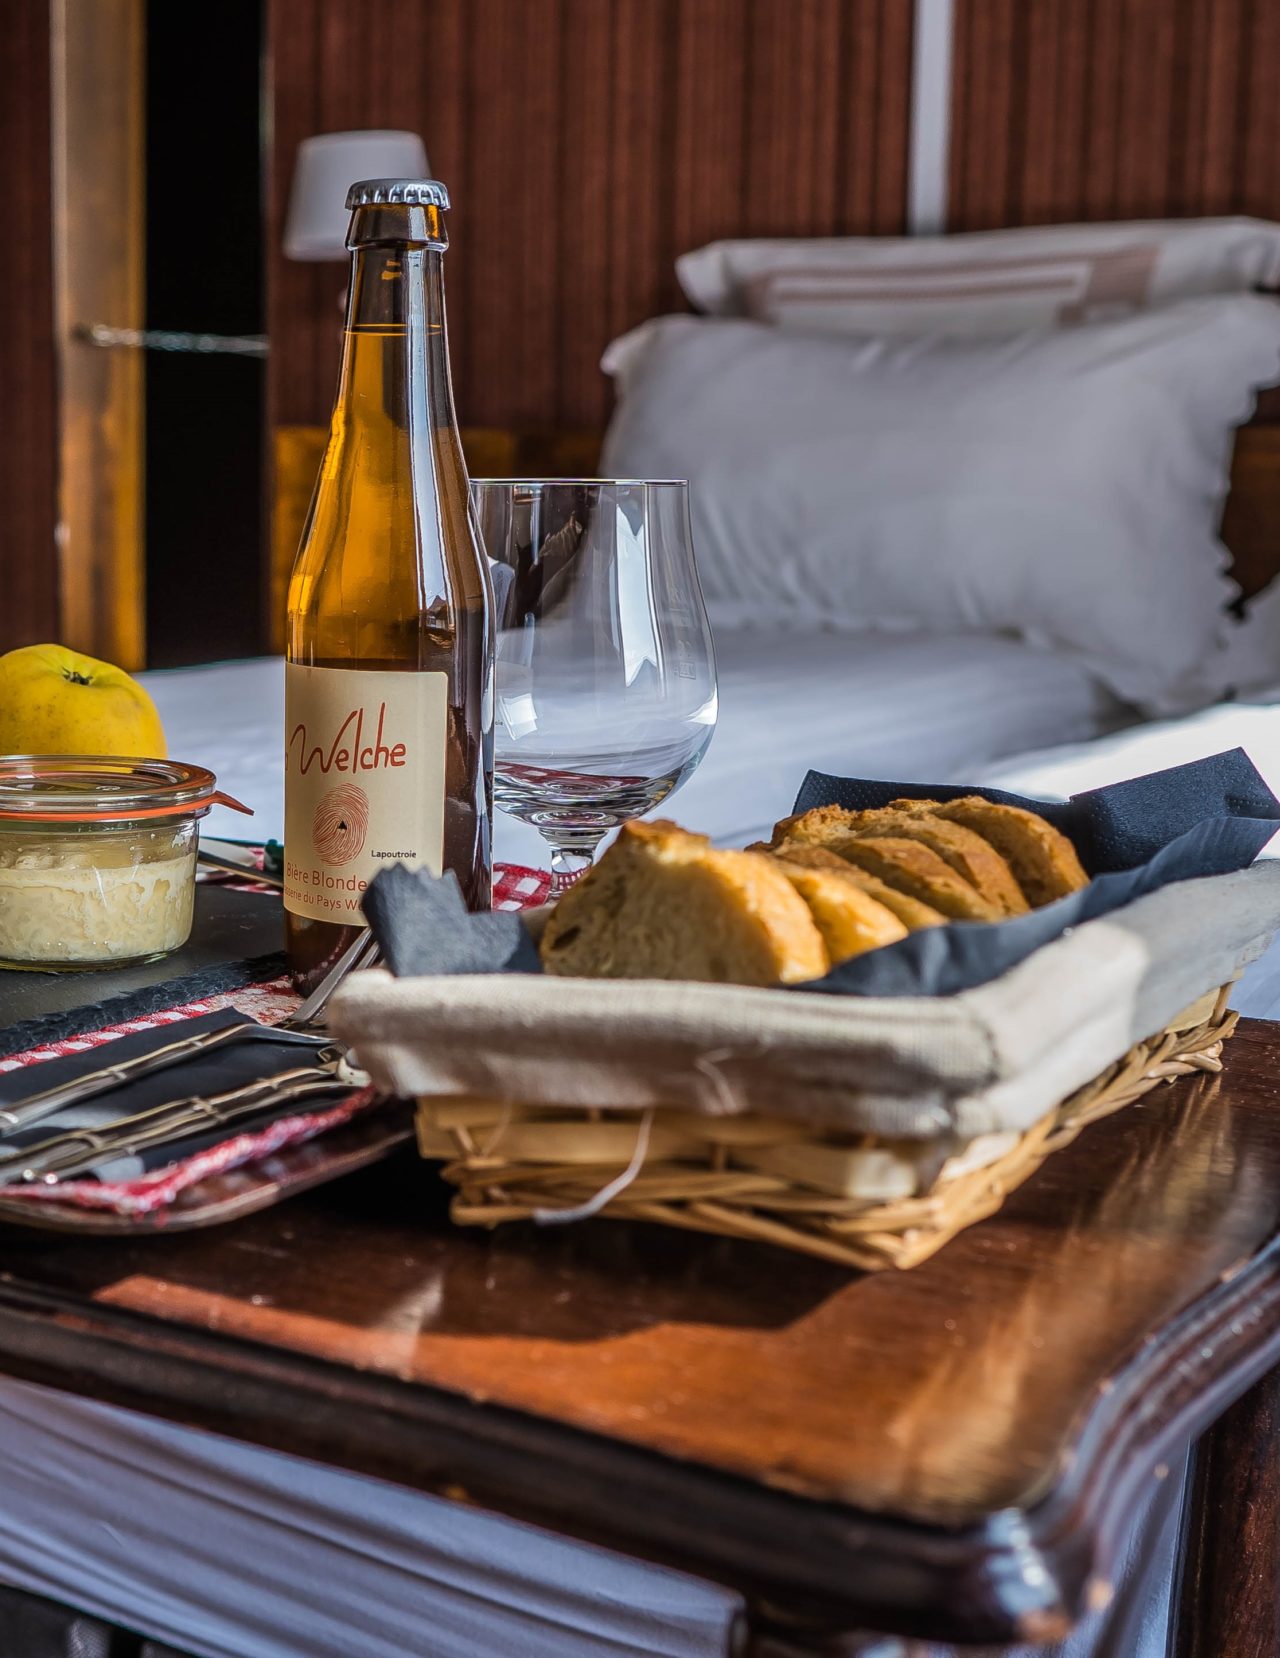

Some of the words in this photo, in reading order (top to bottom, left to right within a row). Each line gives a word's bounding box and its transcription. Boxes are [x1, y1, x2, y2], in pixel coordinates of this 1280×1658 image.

[290, 701, 407, 775] Welche
[371, 849, 417, 860] Lapoutroie
[286, 862, 309, 884] Bière
[312, 870, 368, 892] Blonde
[303, 891, 314, 904] du
[316, 894, 341, 911] Pays
